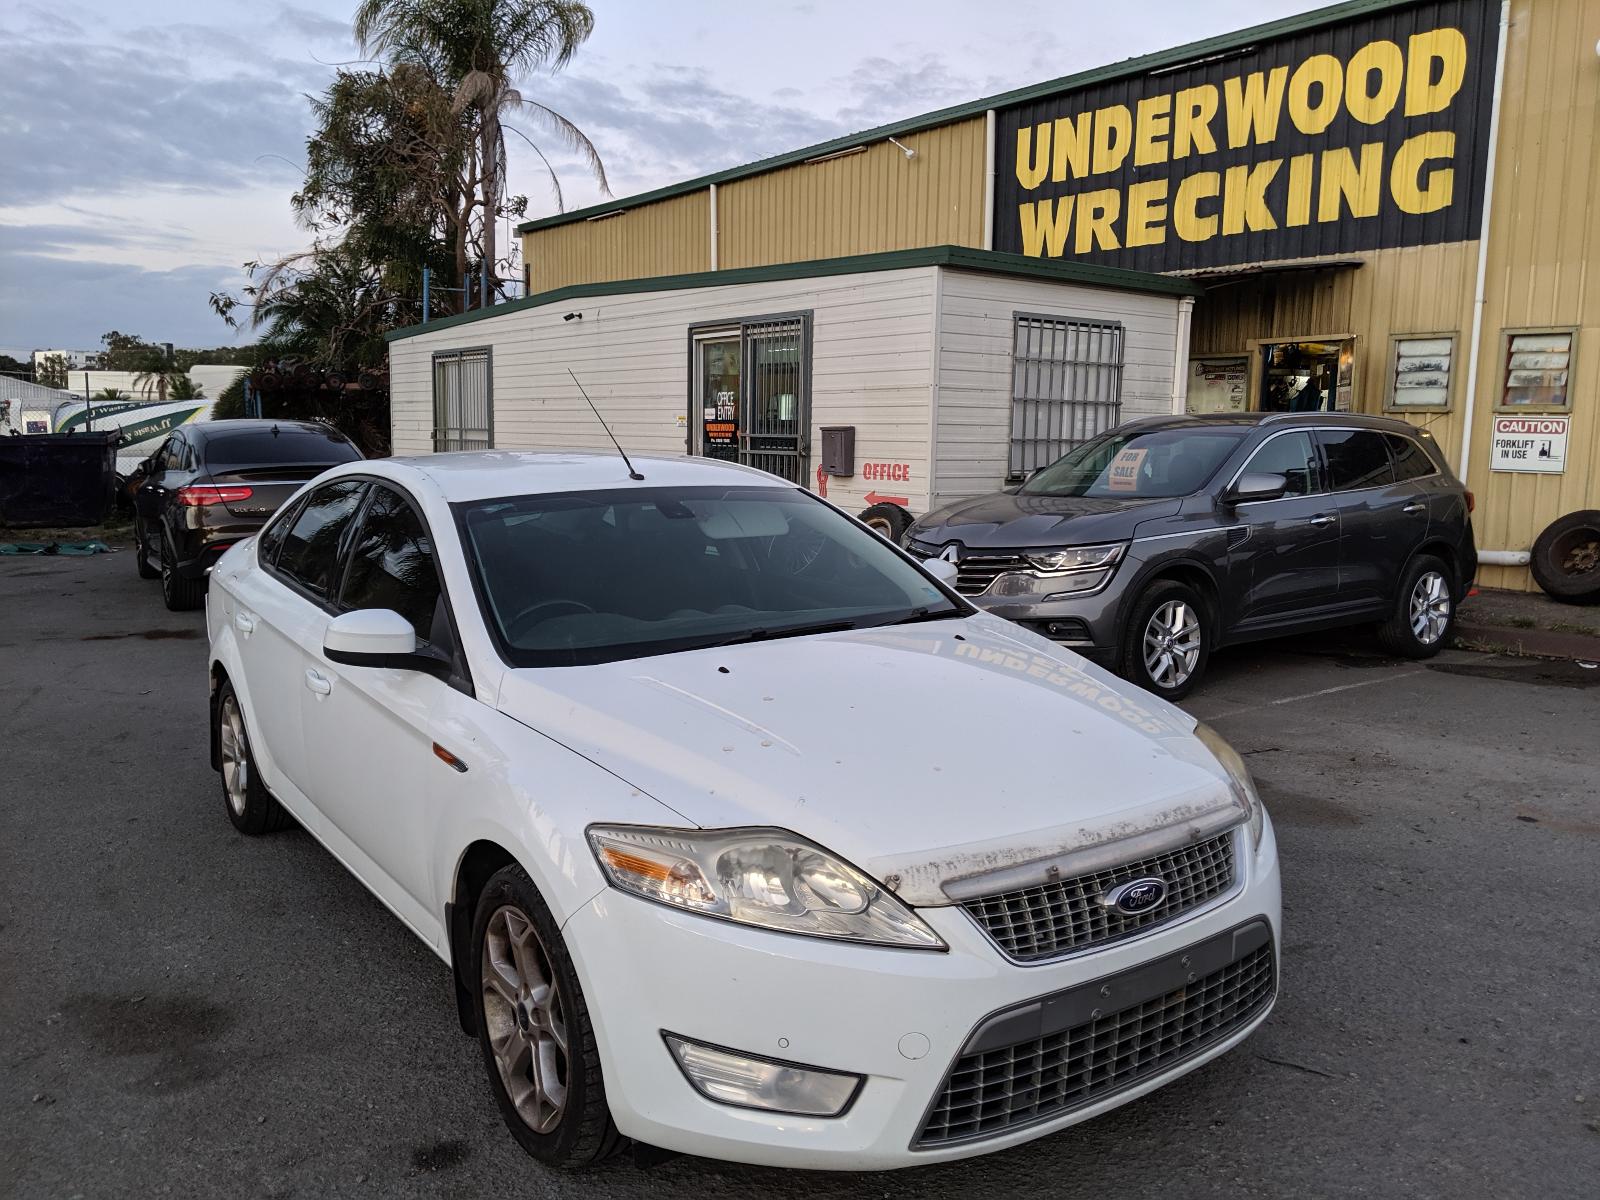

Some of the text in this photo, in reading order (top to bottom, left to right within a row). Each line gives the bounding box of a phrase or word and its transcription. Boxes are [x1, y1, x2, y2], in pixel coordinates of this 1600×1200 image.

[1016, 27, 1467, 191] UNDERWOOD
[1018, 131, 1455, 258] WRECKING
[717, 392, 735, 406] OFFICE
[717, 406, 735, 420] ENTRY
[134, 423, 160, 437] Waste
[1499, 421, 1563, 433] CAUTION
[1495, 439, 1535, 449] FORKLIFT
[1119, 452, 1140, 462] FOR
[1501, 449, 1528, 459] IN USE
[863, 463, 910, 481] OFFICE
[1113, 466, 1135, 478] SALE
[1129, 886, 1156, 907] Ford
